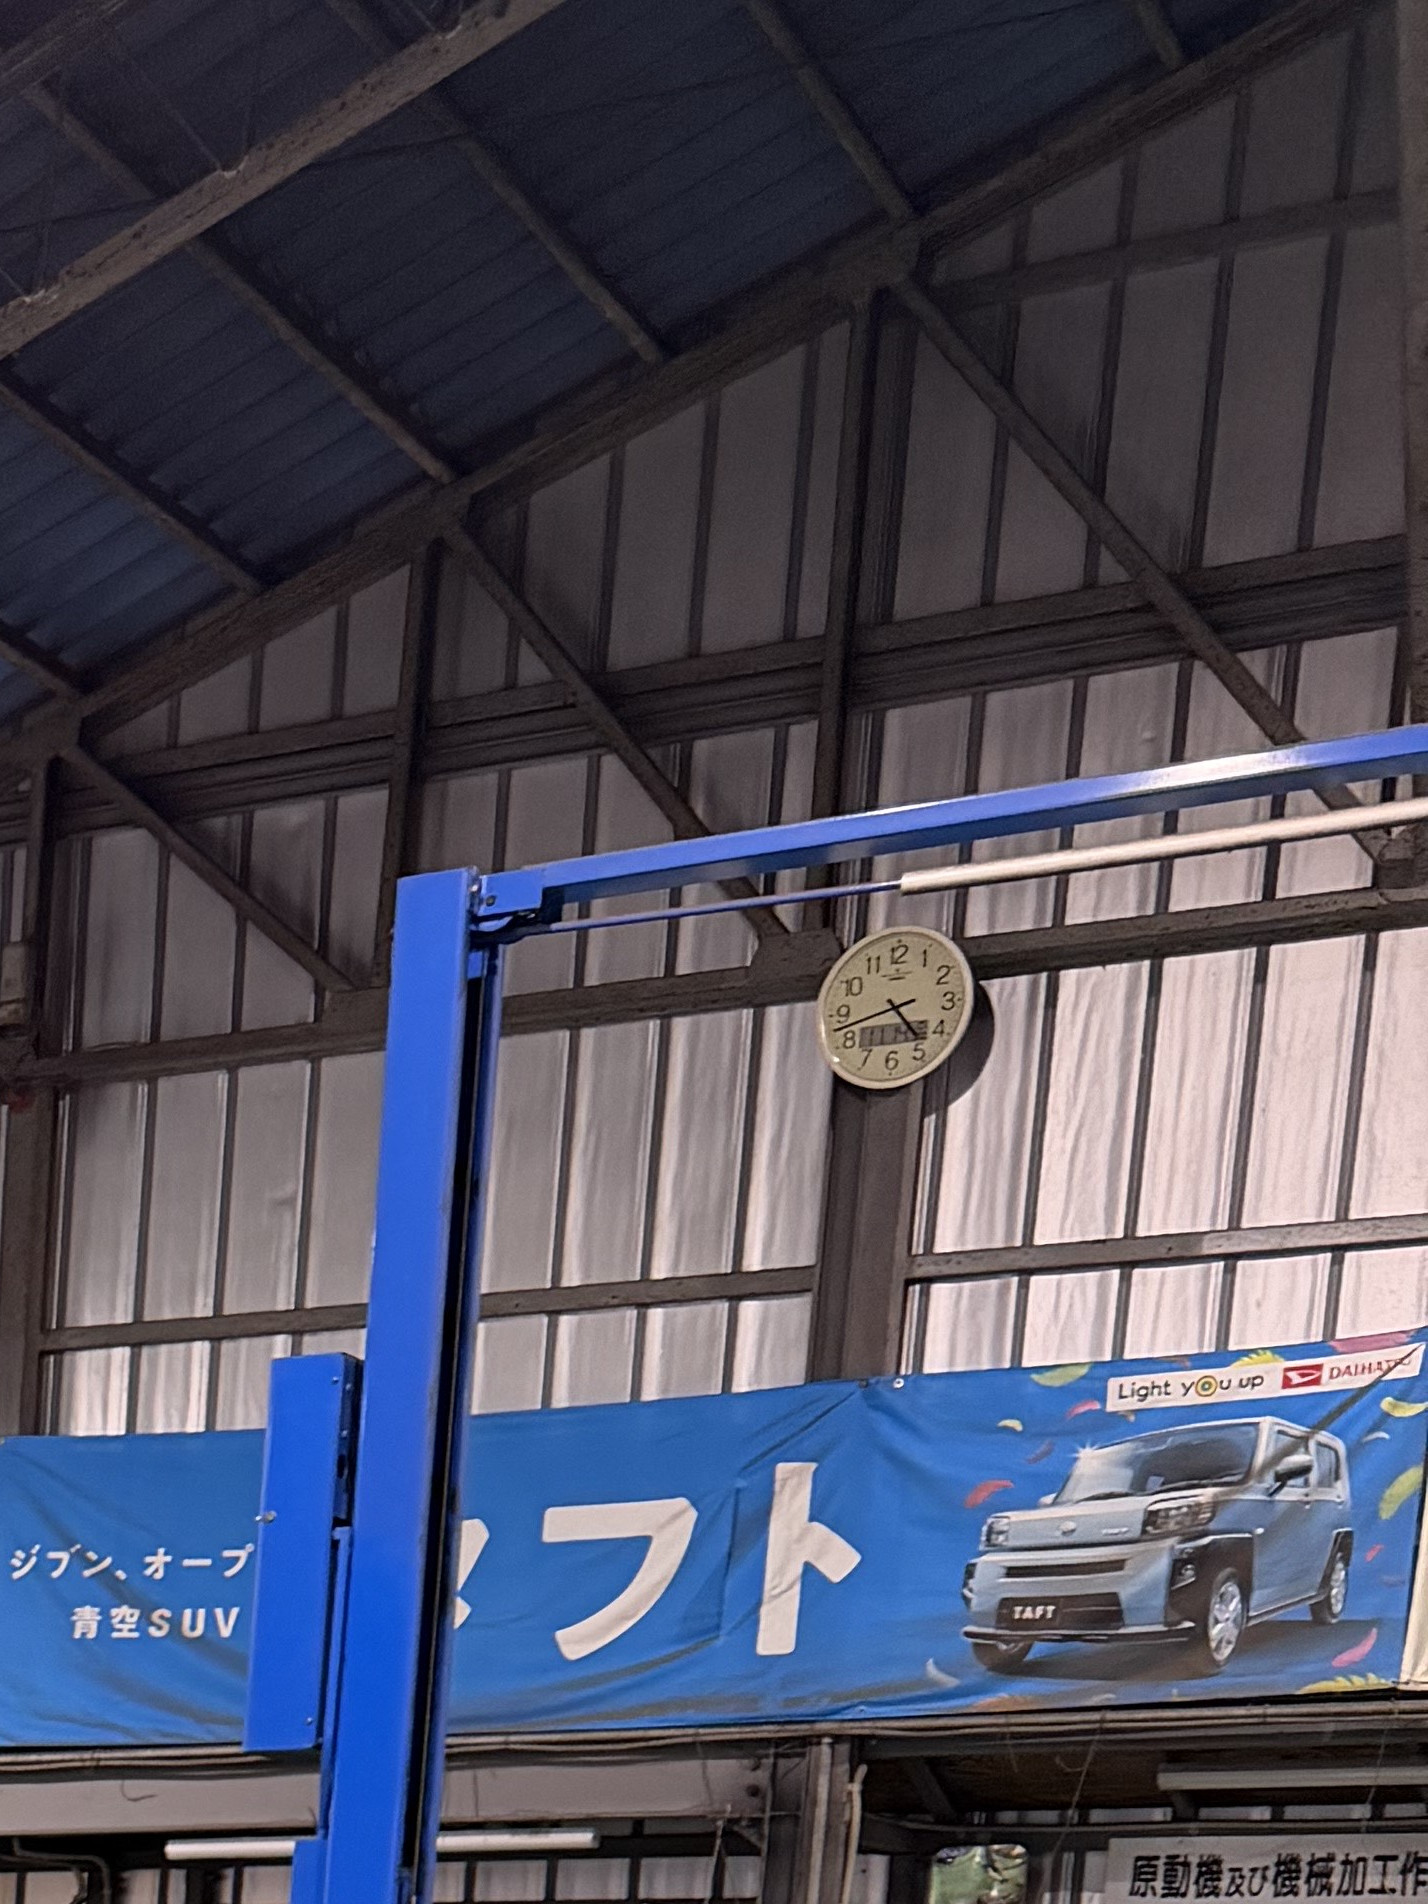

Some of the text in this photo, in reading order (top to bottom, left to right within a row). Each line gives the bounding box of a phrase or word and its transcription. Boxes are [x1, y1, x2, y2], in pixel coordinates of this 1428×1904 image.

[891, 944, 908, 965] 12
[866, 955, 880, 974] 11
[937, 965, 951, 985] 2
[841, 977, 863, 996] 10
[941, 991, 955, 1010] 3
[837, 1004, 850, 1023] 9
[932, 1020, 945, 1036] 4
[843, 1029, 855, 1048] 8
[860, 1049, 872, 1067] 7
[885, 1051, 899, 1070] 6
[913, 1043, 926, 1061] 5
[1118, 1380, 1171, 1402] Light
[1239, 1374, 1265, 1391] up
[454, 1461, 862, 1661] フト
[1013, 1605, 1056, 1620] TAFT
